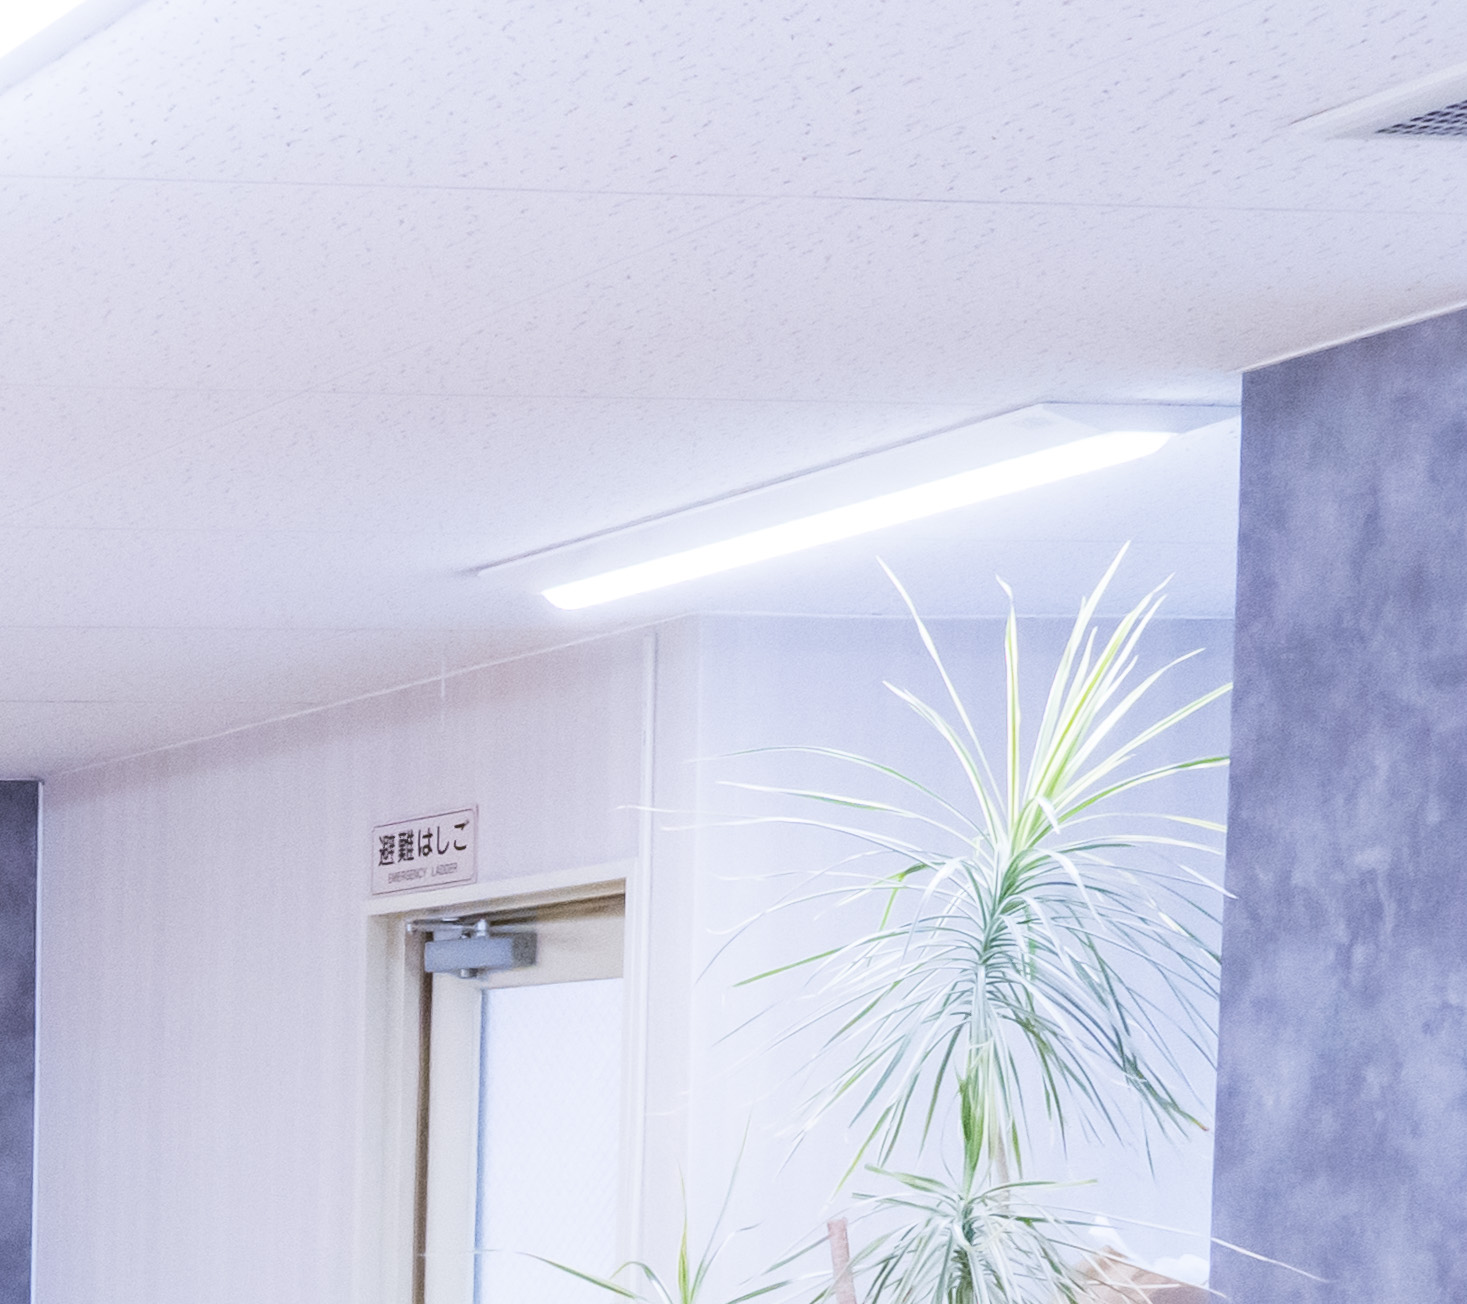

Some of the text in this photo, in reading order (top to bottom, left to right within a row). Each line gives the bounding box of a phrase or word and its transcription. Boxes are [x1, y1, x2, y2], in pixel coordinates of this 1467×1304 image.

[379, 820, 470, 866] 避難はしご
